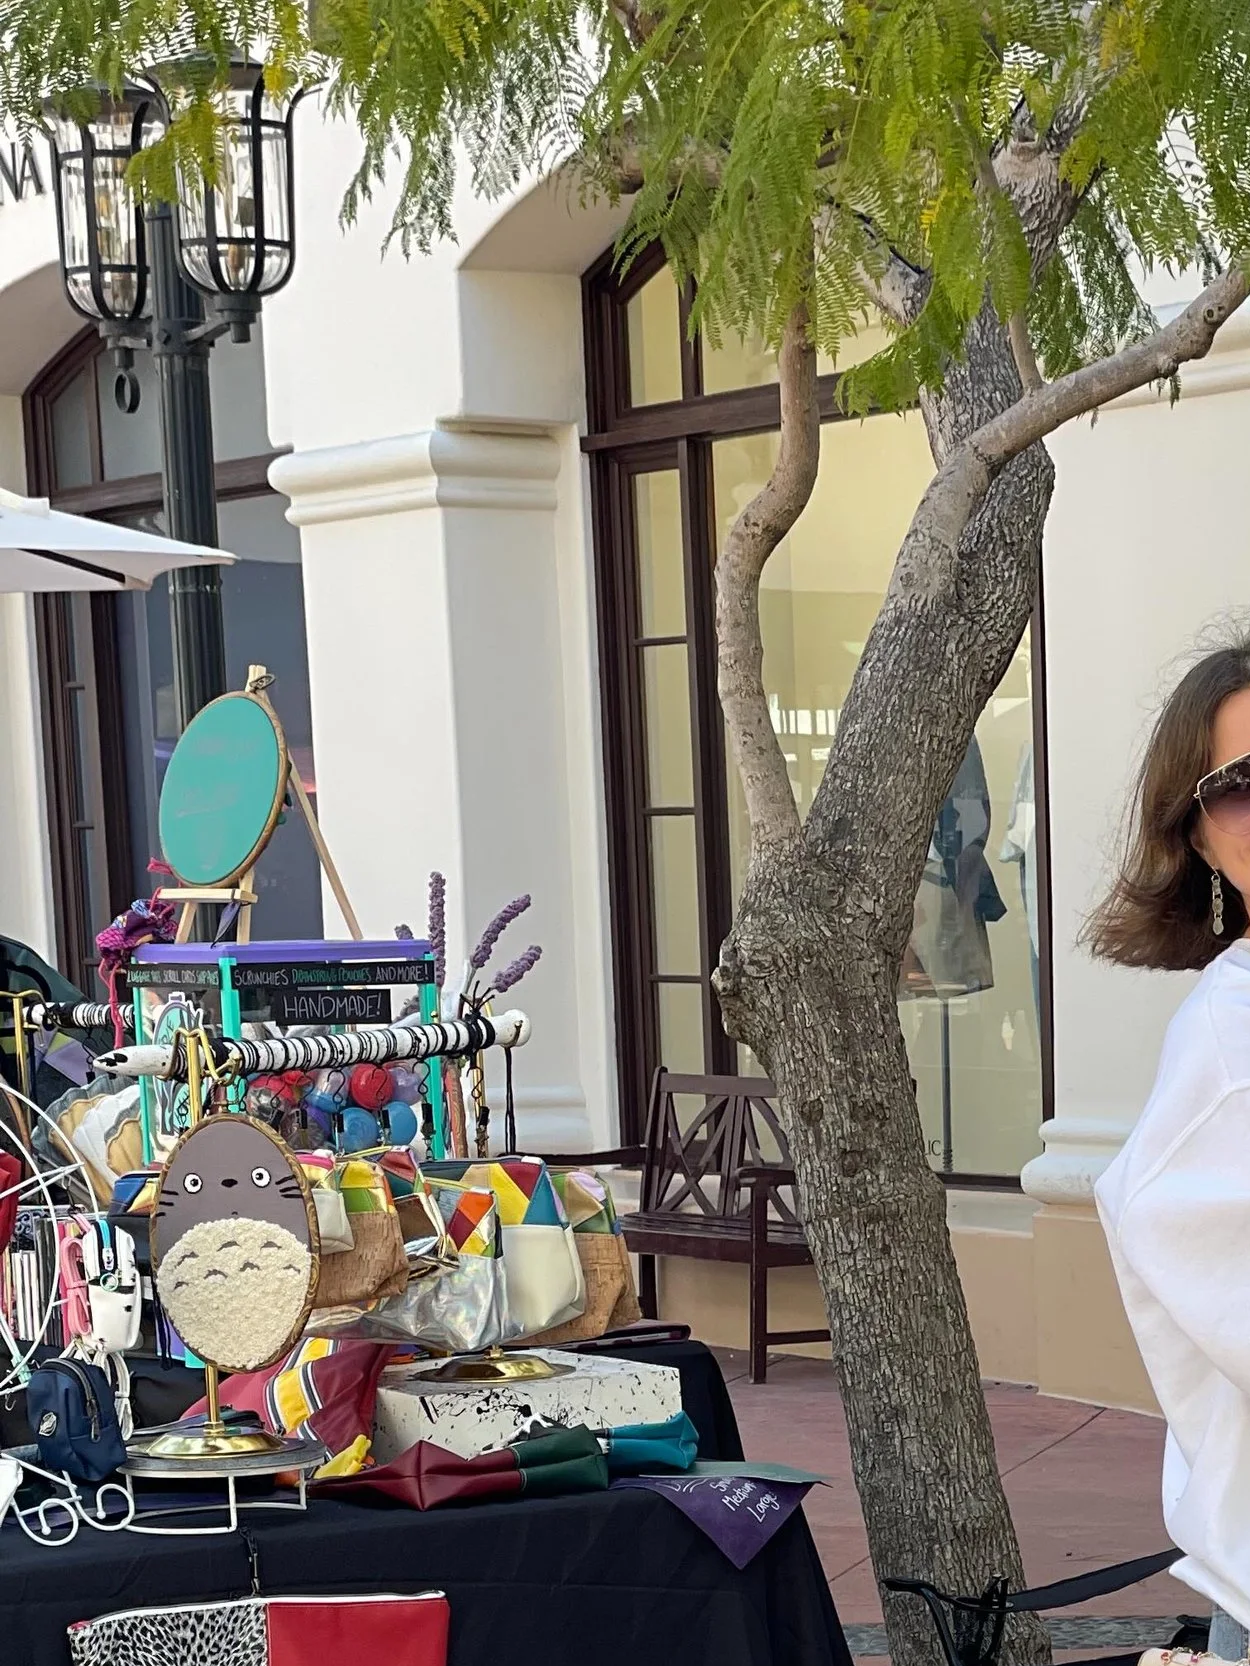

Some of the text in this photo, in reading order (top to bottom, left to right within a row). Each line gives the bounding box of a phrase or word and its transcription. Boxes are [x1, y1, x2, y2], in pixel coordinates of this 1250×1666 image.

[375, 966, 396, 981] AND
[397, 963, 429, 981] MORE!
[284, 993, 382, 1019] HANDMADE!
